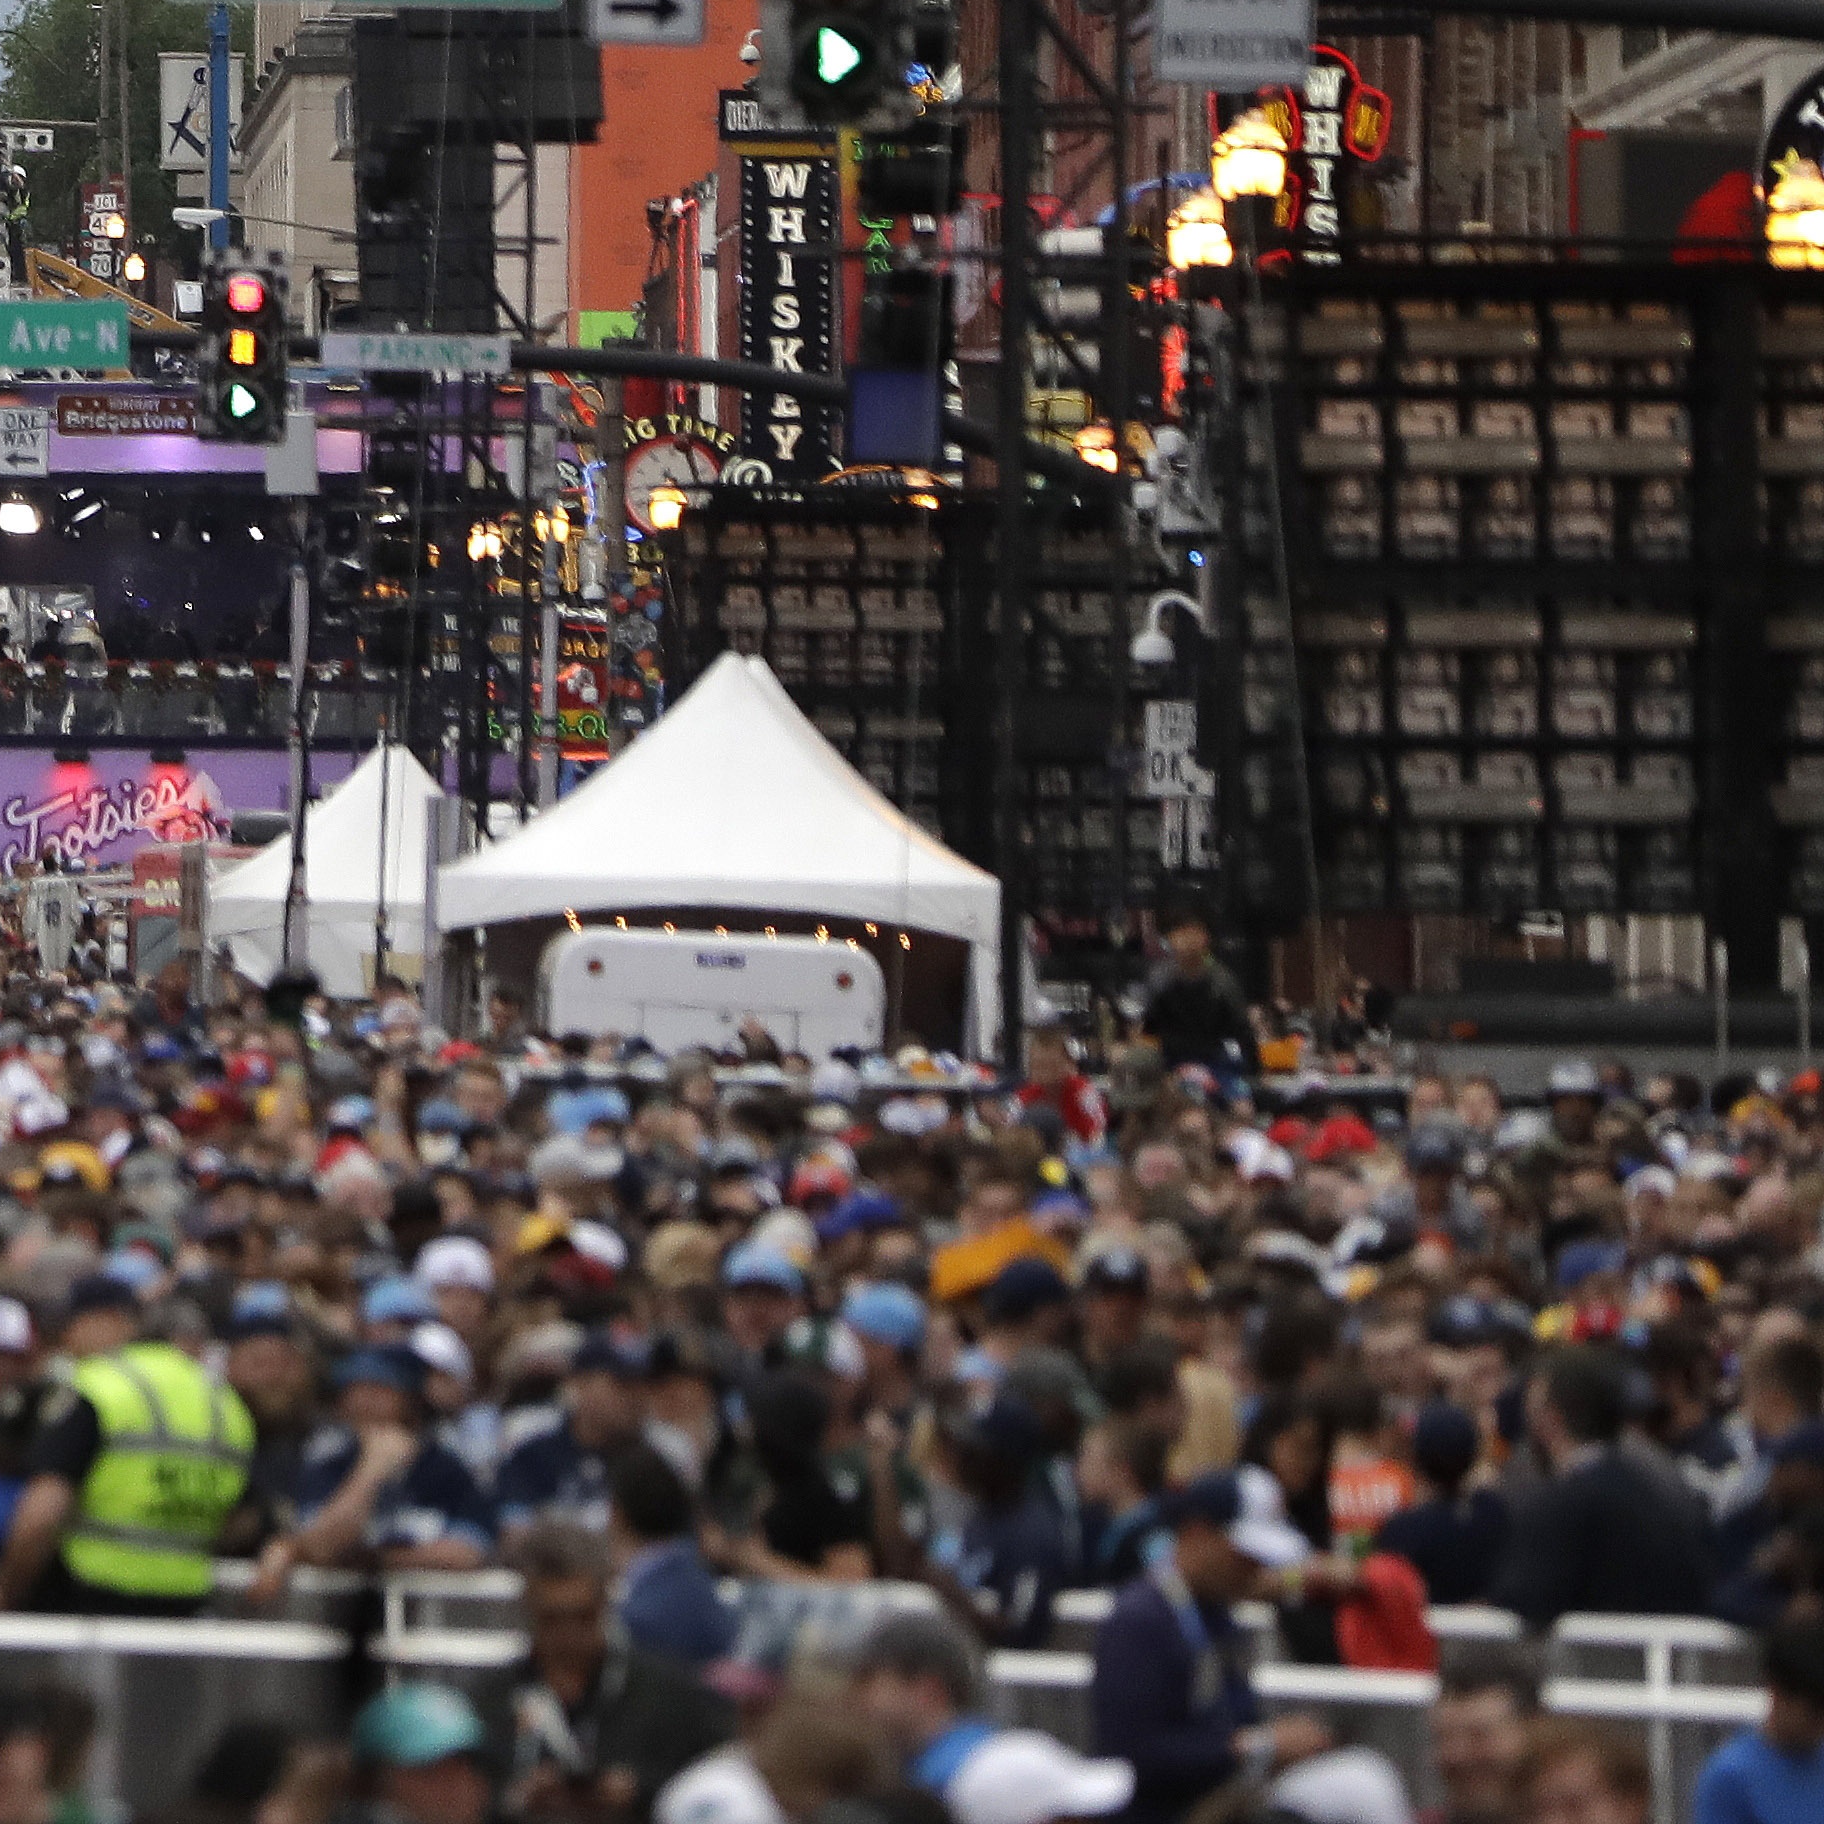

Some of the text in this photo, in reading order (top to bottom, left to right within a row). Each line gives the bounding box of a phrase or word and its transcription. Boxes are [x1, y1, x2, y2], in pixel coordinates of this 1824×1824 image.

[761, 161, 812, 461] WHISKEY
[4, 413, 42, 429] ONE
[65, 410, 188, 436] Bridgestone
[667, 413, 736, 452] TIME
[2, 431, 43, 449] WAY
